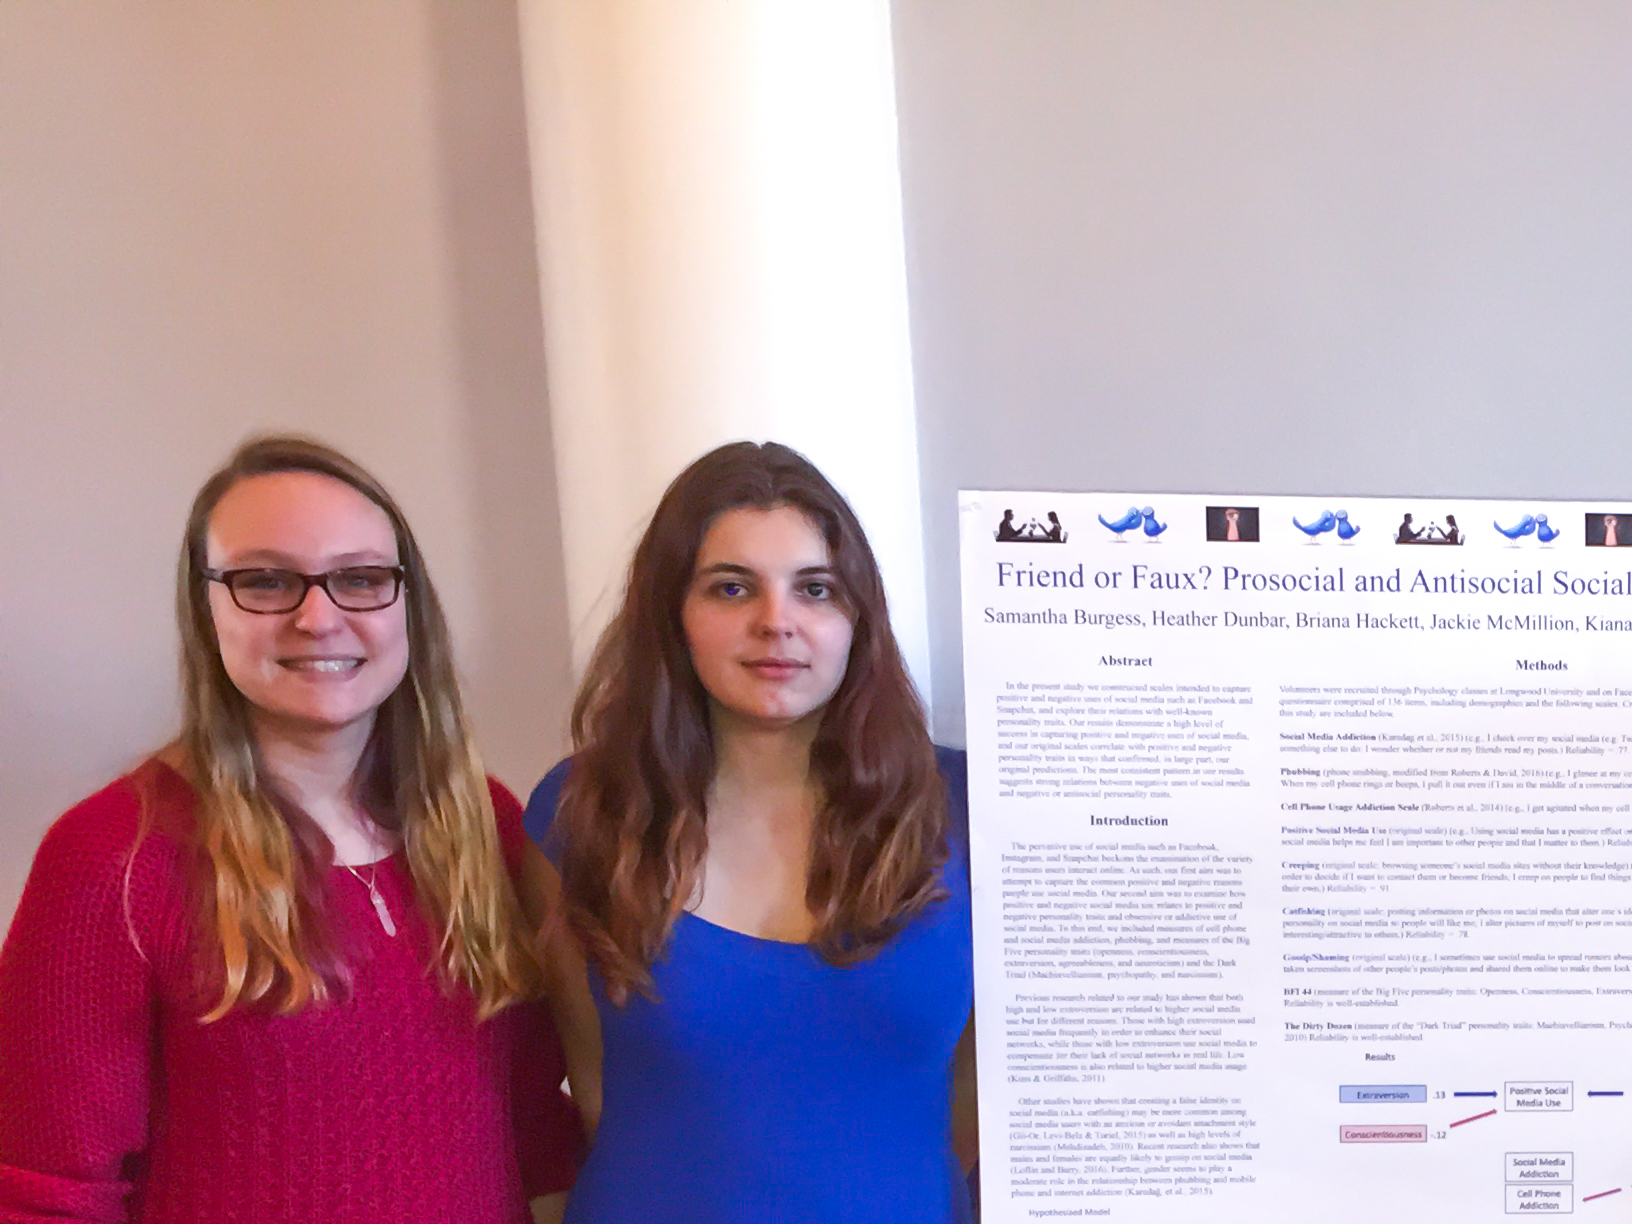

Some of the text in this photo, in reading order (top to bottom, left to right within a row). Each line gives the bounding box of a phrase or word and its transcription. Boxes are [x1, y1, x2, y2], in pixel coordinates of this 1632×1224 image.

[996, 561, 1084, 588] Friend
[1094, 571, 1122, 589] or
[1132, 564, 1211, 590] Faux?
[1222, 565, 1344, 592] Prosocial
[1354, 567, 1401, 592] and
[1409, 568, 1541, 594] Antisocial
[1553, 570, 1631, 595] Social
[984, 607, 1067, 624] Samantha
[1074, 608, 1146, 630] Burgess,
[1152, 609, 1218, 626] Heather
[1223, 610, 1290, 628] Dunbar,
[1296, 611, 1350, 628] Briana
[1356, 612, 1424, 630] Hackett,
[1429, 613, 1480, 630] Jackie
[1487, 614, 1579, 632] McMillion,
[1585, 615, 1632, 631] Kiana
[1098, 654, 1152, 666] Abstract
[1516, 658, 1568, 671] Methods
[1090, 814, 1168, 826] Introduction
